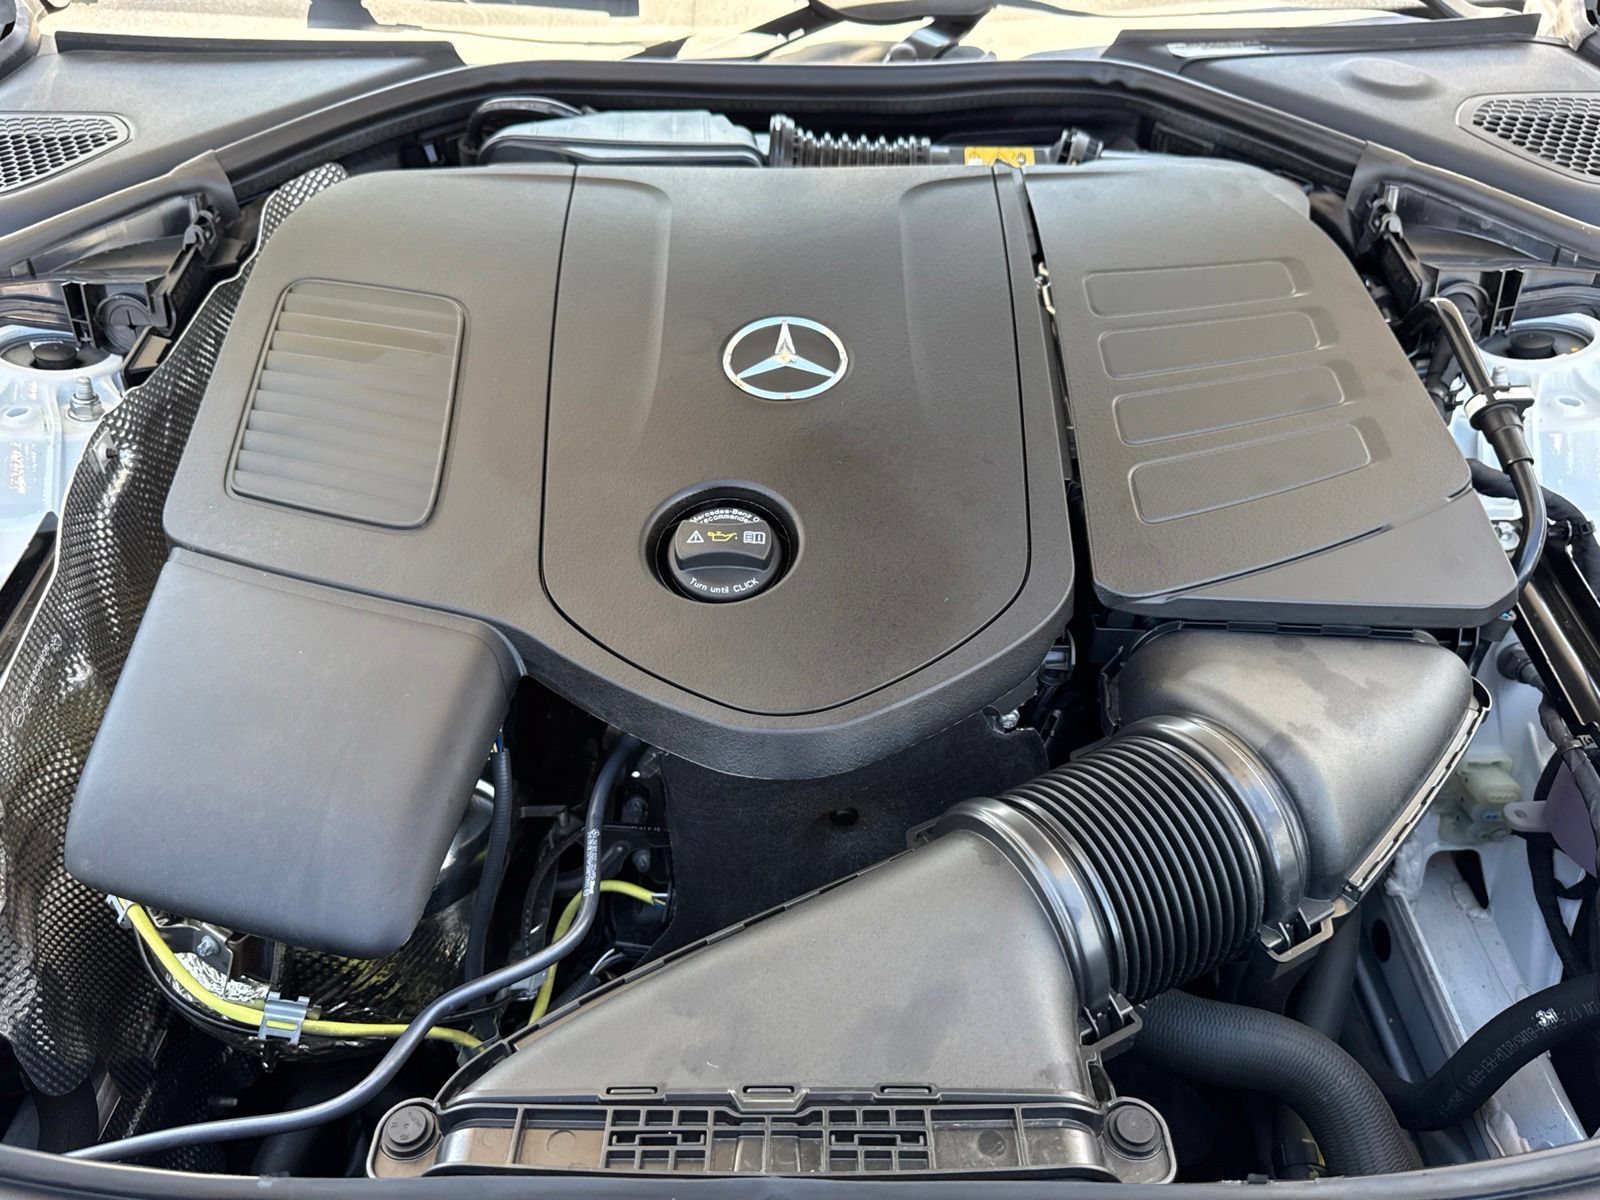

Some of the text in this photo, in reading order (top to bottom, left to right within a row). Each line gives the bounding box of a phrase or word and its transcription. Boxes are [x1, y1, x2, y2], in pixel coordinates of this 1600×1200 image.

[689, 508, 752, 523] Mercedes-Benz
[689, 577, 759, 594] Turn until CLICK
